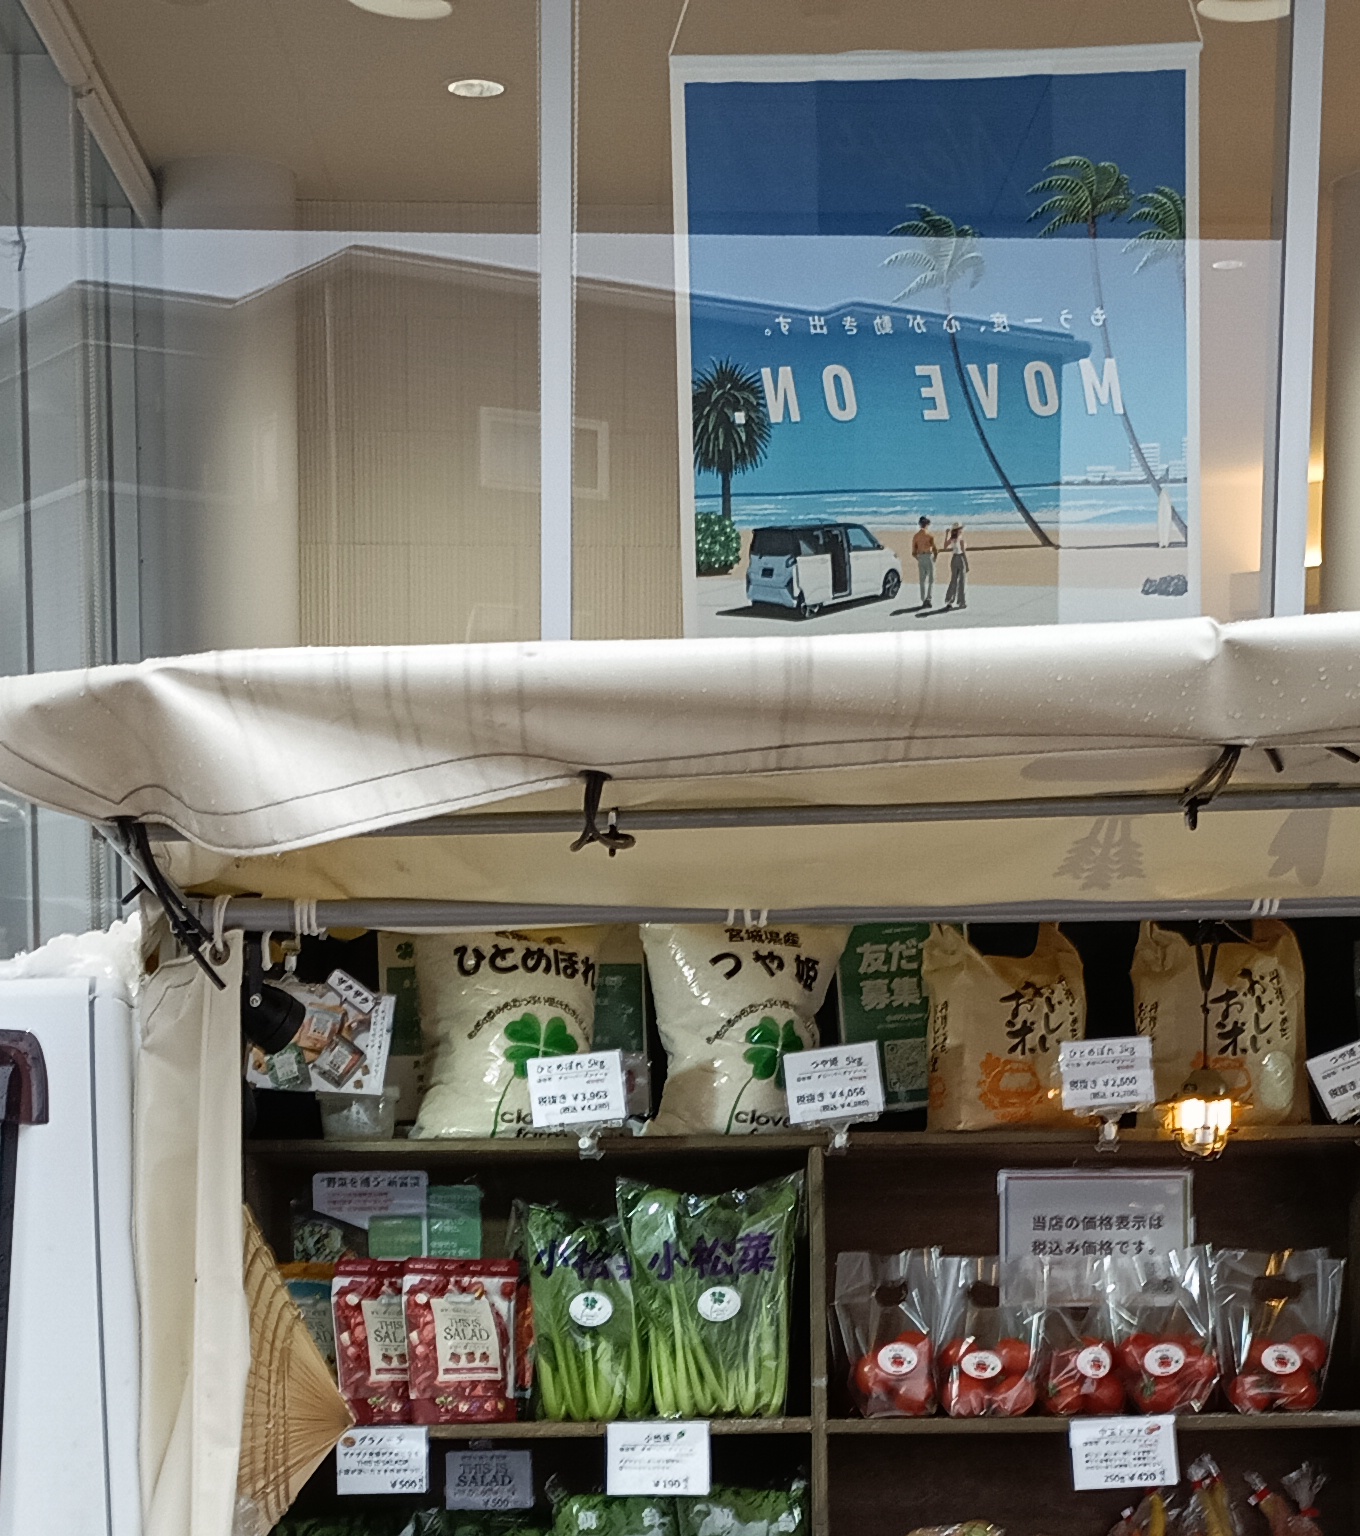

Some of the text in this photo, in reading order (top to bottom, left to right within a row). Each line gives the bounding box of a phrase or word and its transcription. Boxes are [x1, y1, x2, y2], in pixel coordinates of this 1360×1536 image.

[856, 938, 924, 975] 友だ
[709, 950, 820, 993] つや姫
[1031, 1213, 1165, 1232] 当店の価格表示は
[1030, 1239, 1158, 1257] 税込み価格です。
[647, 1231, 777, 1283] 小松菜
[449, 1318, 471, 1328] THIS
[443, 1327, 491, 1341] SALAD
[459, 1463, 509, 1475] THIS IS
[390, 1479, 417, 1489] ¥500
[454, 1474, 514, 1487] SALAD
[652, 1479, 681, 1489] ¥190
